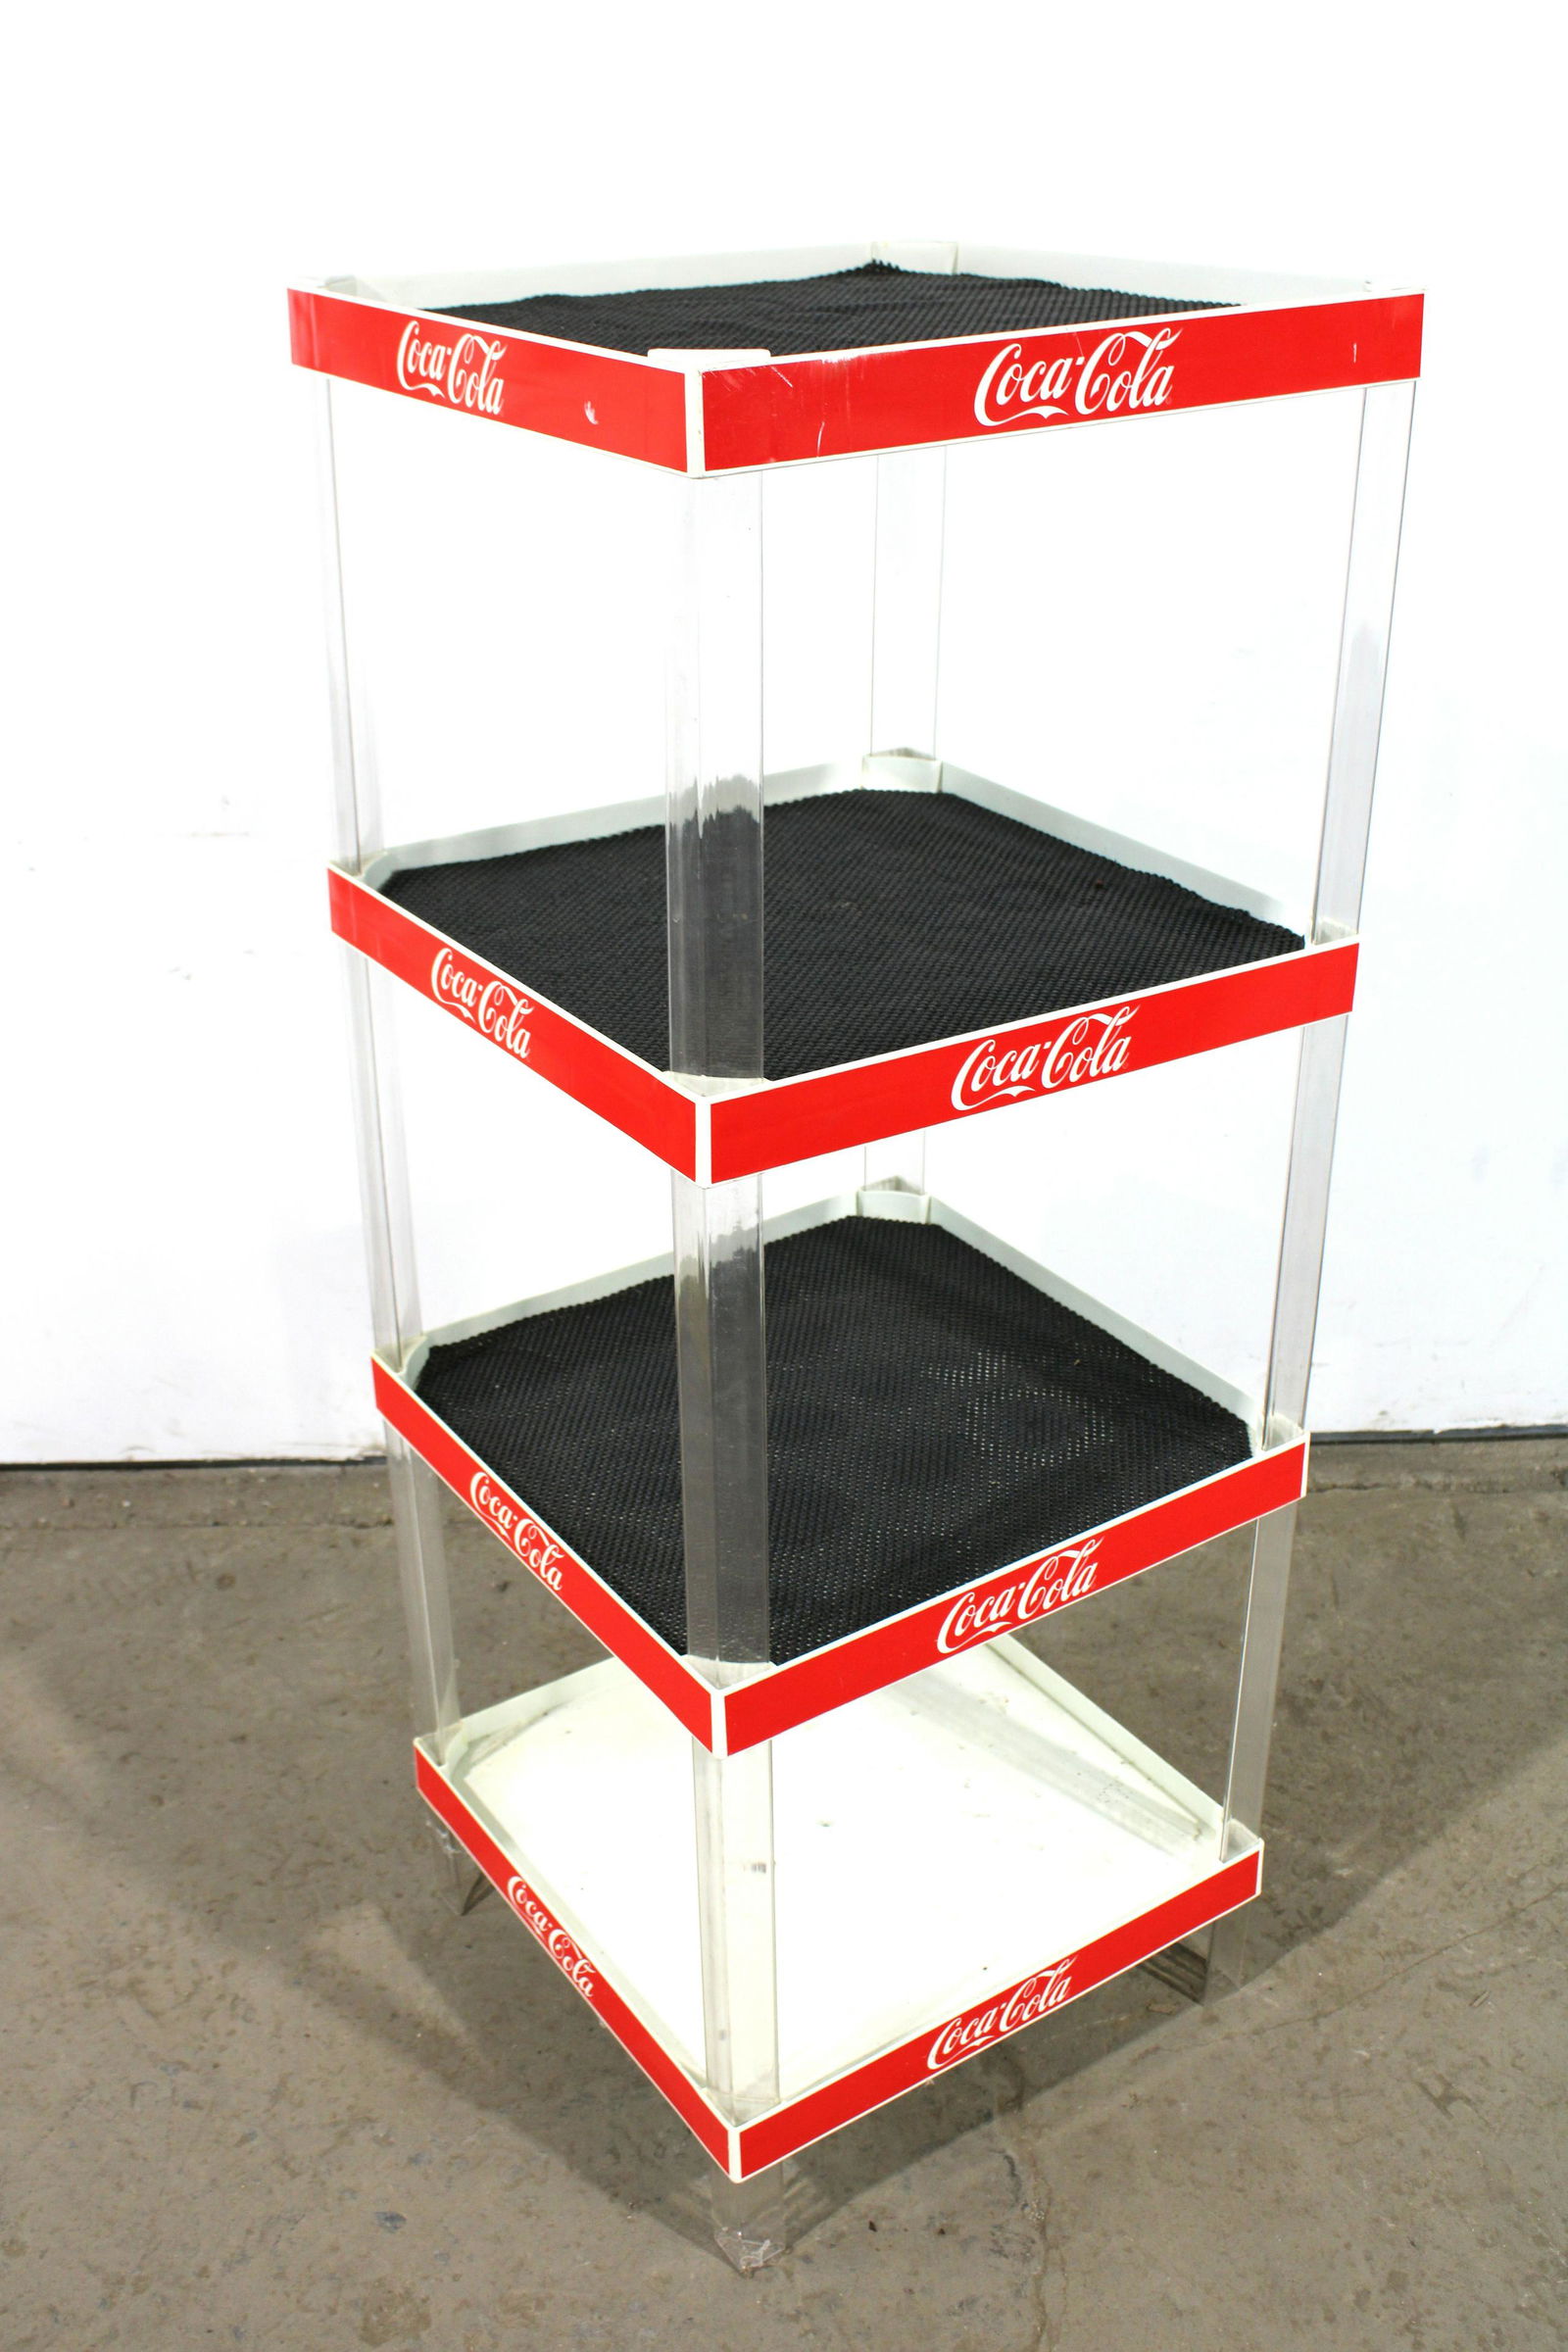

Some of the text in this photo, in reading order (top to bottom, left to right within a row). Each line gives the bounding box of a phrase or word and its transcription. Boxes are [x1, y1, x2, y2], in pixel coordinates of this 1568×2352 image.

[396, 319, 507, 416] Coca-Cola
[974, 327, 1183, 427] Coca-Cola
[430, 947, 534, 1059] Coca-Cola
[950, 1005, 1140, 1111] Coca-Cola
[469, 1471, 564, 1592] Coca-Cola
[936, 1538, 1103, 1654] Coca-Cola
[507, 1875, 594, 1997] Coca-Cola
[926, 1956, 1077, 2070] Coca-Cola
